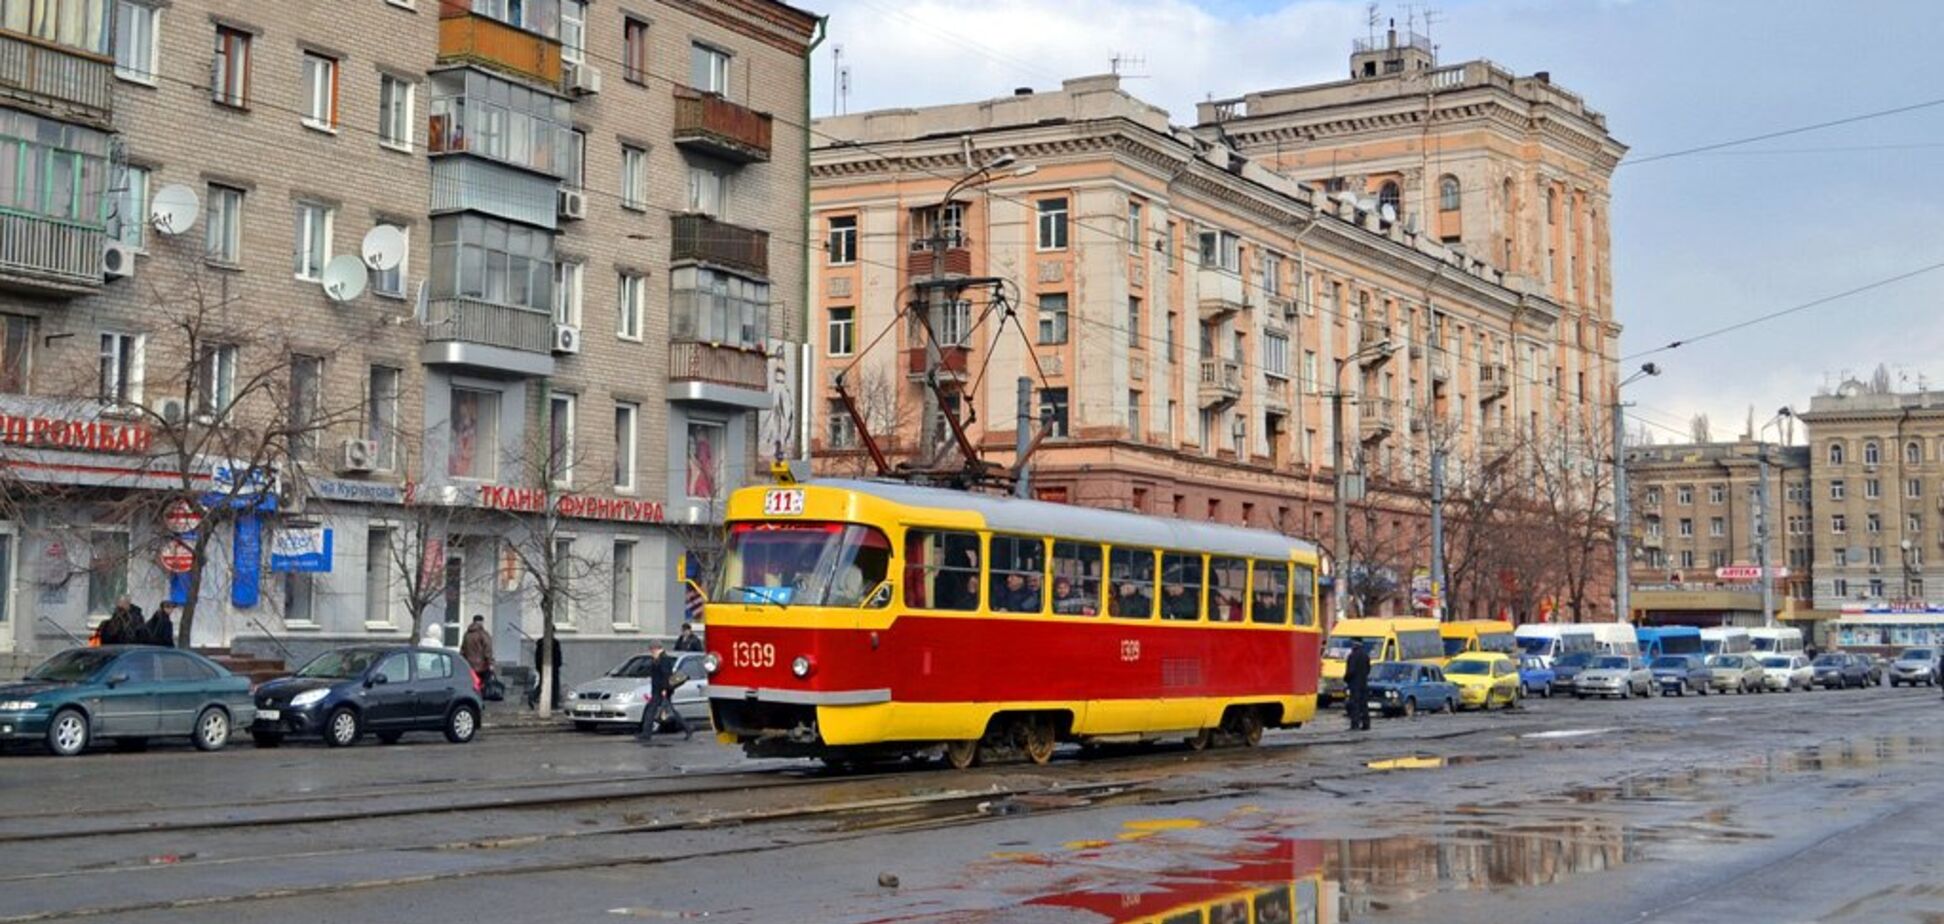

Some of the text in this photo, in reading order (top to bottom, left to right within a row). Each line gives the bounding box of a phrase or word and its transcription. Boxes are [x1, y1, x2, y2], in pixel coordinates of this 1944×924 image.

[482, 485, 664, 521] ТКАНИ ФУРНИТУРА
[774, 492, 791, 511] 11
[1722, 568, 1758, 577] АПТЕКА
[732, 641, 775, 668] 1309
